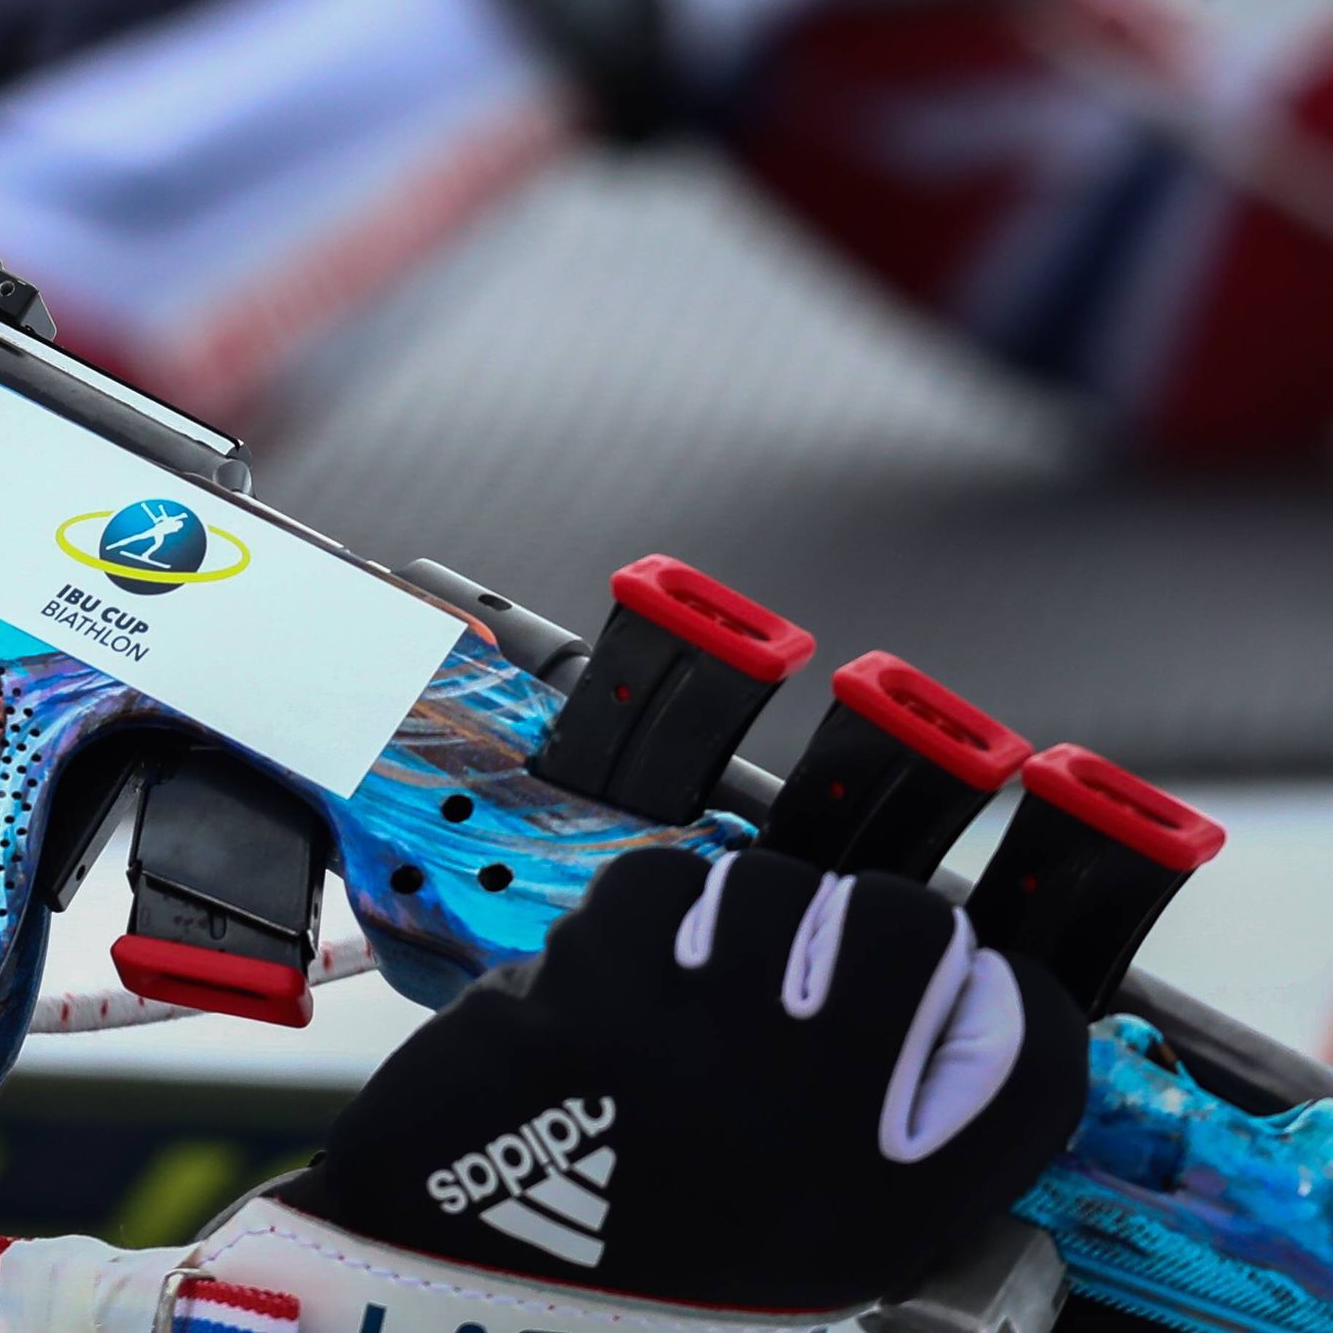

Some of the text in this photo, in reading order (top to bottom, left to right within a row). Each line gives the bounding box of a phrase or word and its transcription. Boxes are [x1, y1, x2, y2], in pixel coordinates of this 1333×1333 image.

[41, 600, 151, 663] BIATHLON
[56, 584, 150, 635] IBU CUP
[426, 1096, 617, 1214] adidas
